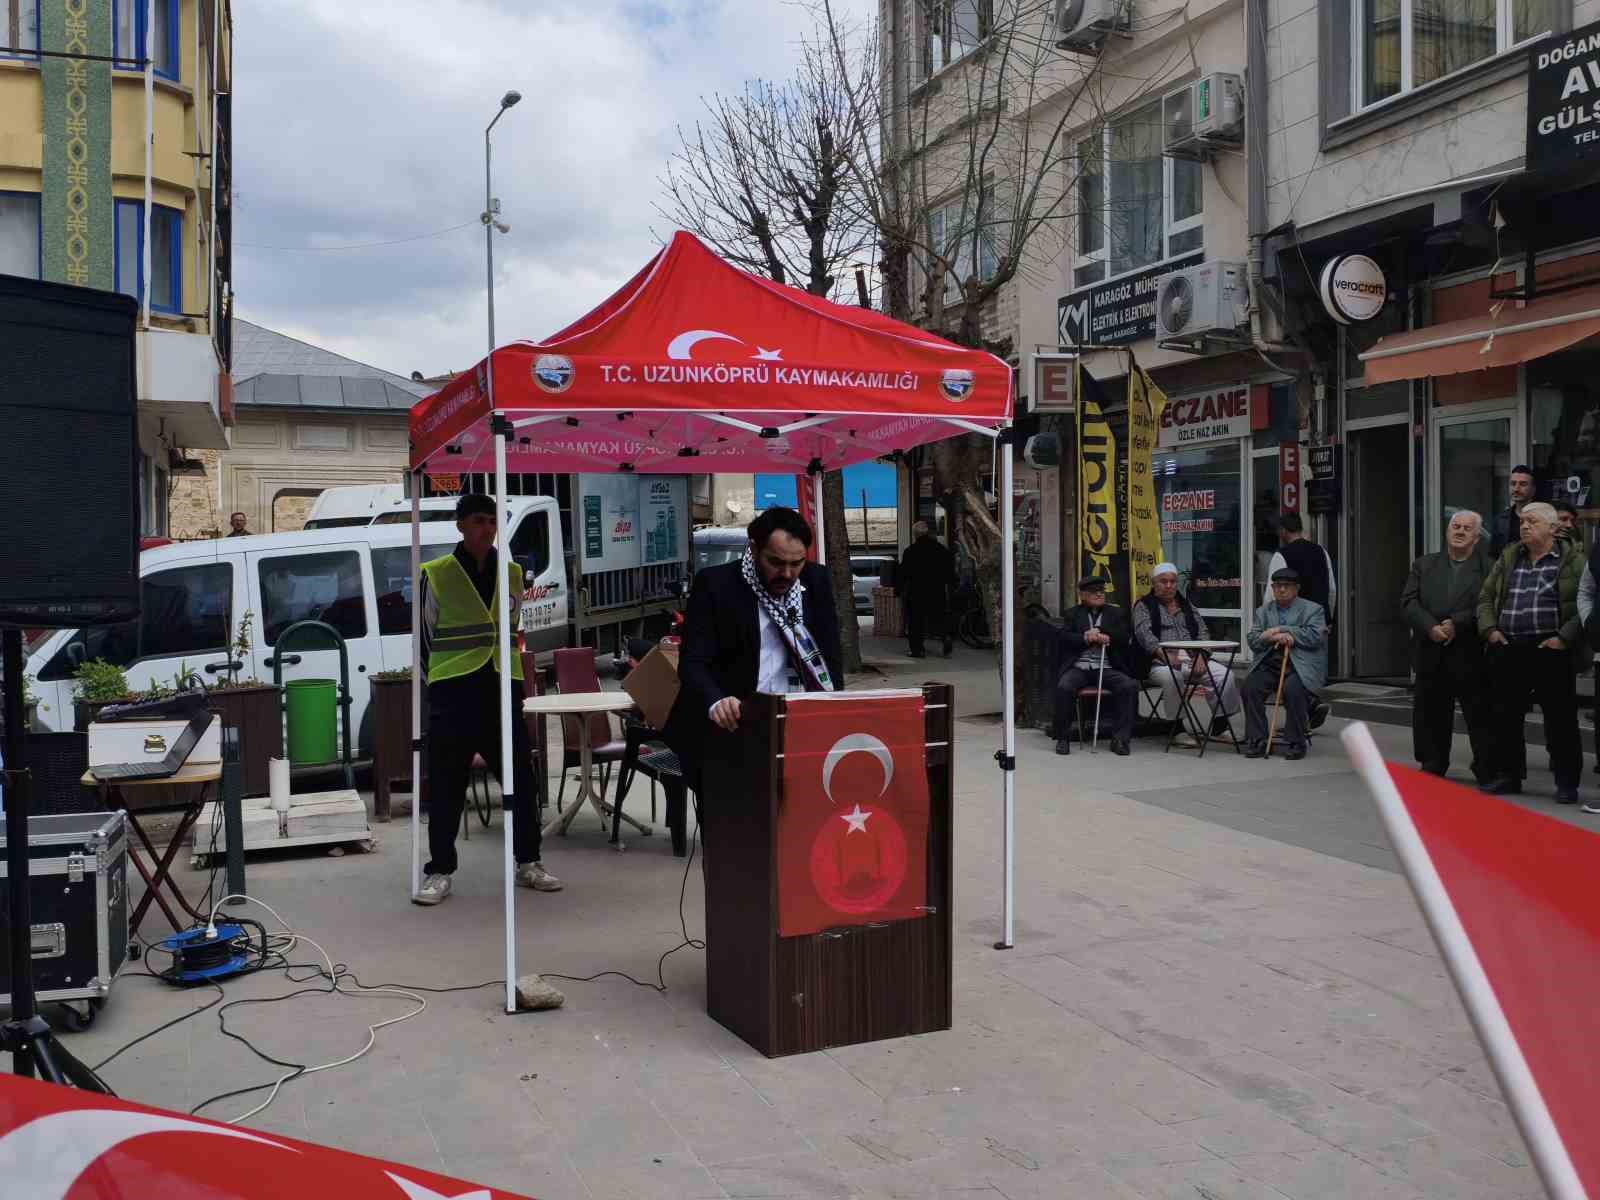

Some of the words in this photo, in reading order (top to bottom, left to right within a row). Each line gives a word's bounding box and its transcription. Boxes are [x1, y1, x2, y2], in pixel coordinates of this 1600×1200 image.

[1538, 33, 1600, 70] DOĞAN
[1094, 283, 1132, 309] KARAGÖZ
[1135, 276, 1159, 296] MÜHE
[600, 365, 637, 382] T.C.
[644, 363, 769, 383] UZUNKÖPRÜ
[775, 367, 919, 390] KAYMAKAMLIĞI
[1043, 366, 1068, 400] E
[1160, 389, 1248, 428] ECZANE
[1163, 490, 1216, 512] ECZANE
